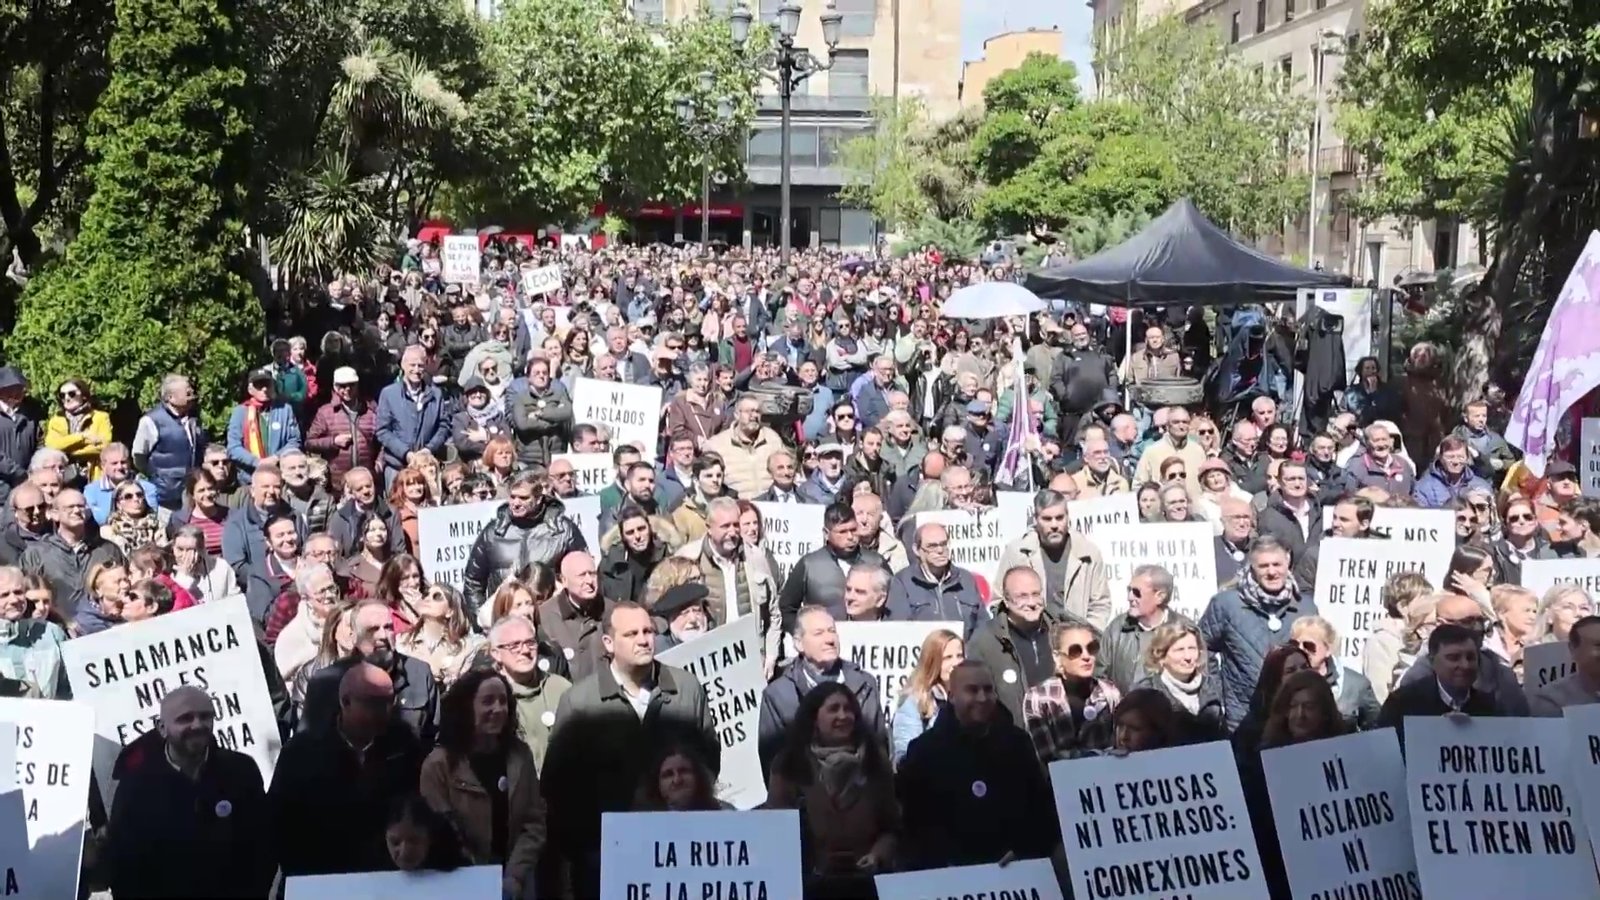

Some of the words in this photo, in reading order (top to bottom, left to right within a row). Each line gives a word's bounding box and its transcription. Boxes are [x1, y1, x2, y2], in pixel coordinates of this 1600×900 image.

[611, 391, 625, 406] NI
[586, 405, 645, 426] AISLADOS
[1111, 540, 1148, 557] TREN
[1157, 539, 1197, 557] RUTA
[1339, 559, 1377, 579] TREN
[1330, 584, 1345, 603] DE
[1355, 584, 1370, 604] LA
[85, 625, 239, 688] SALAMANCA
[852, 645, 921, 669] MENOS
[135, 678, 166, 709] NO
[47, 763, 70, 786] DE
[1323, 758, 1349, 792] NI
[1440, 745, 1545, 774] PORTUGAL
[1079, 784, 1106, 816] NI
[1115, 772, 1218, 811] EXCUSAS
[1421, 779, 1474, 812] ESTÁ
[1484, 783, 1508, 812] AL
[1516, 783, 1571, 818] LADO,
[1075, 815, 1103, 849] NI
[1112, 804, 1236, 845] RETRASOS:
[1300, 791, 1394, 841] AISLADOS
[1428, 820, 1460, 855] EL
[1465, 820, 1532, 855] TREN
[1541, 820, 1576, 855] NO
[654, 841, 677, 868] LA
[690, 840, 750, 867] RUTA
[1342, 838, 1369, 874] NI
[1084, 849, 1250, 900] ¡CONEXIONES
